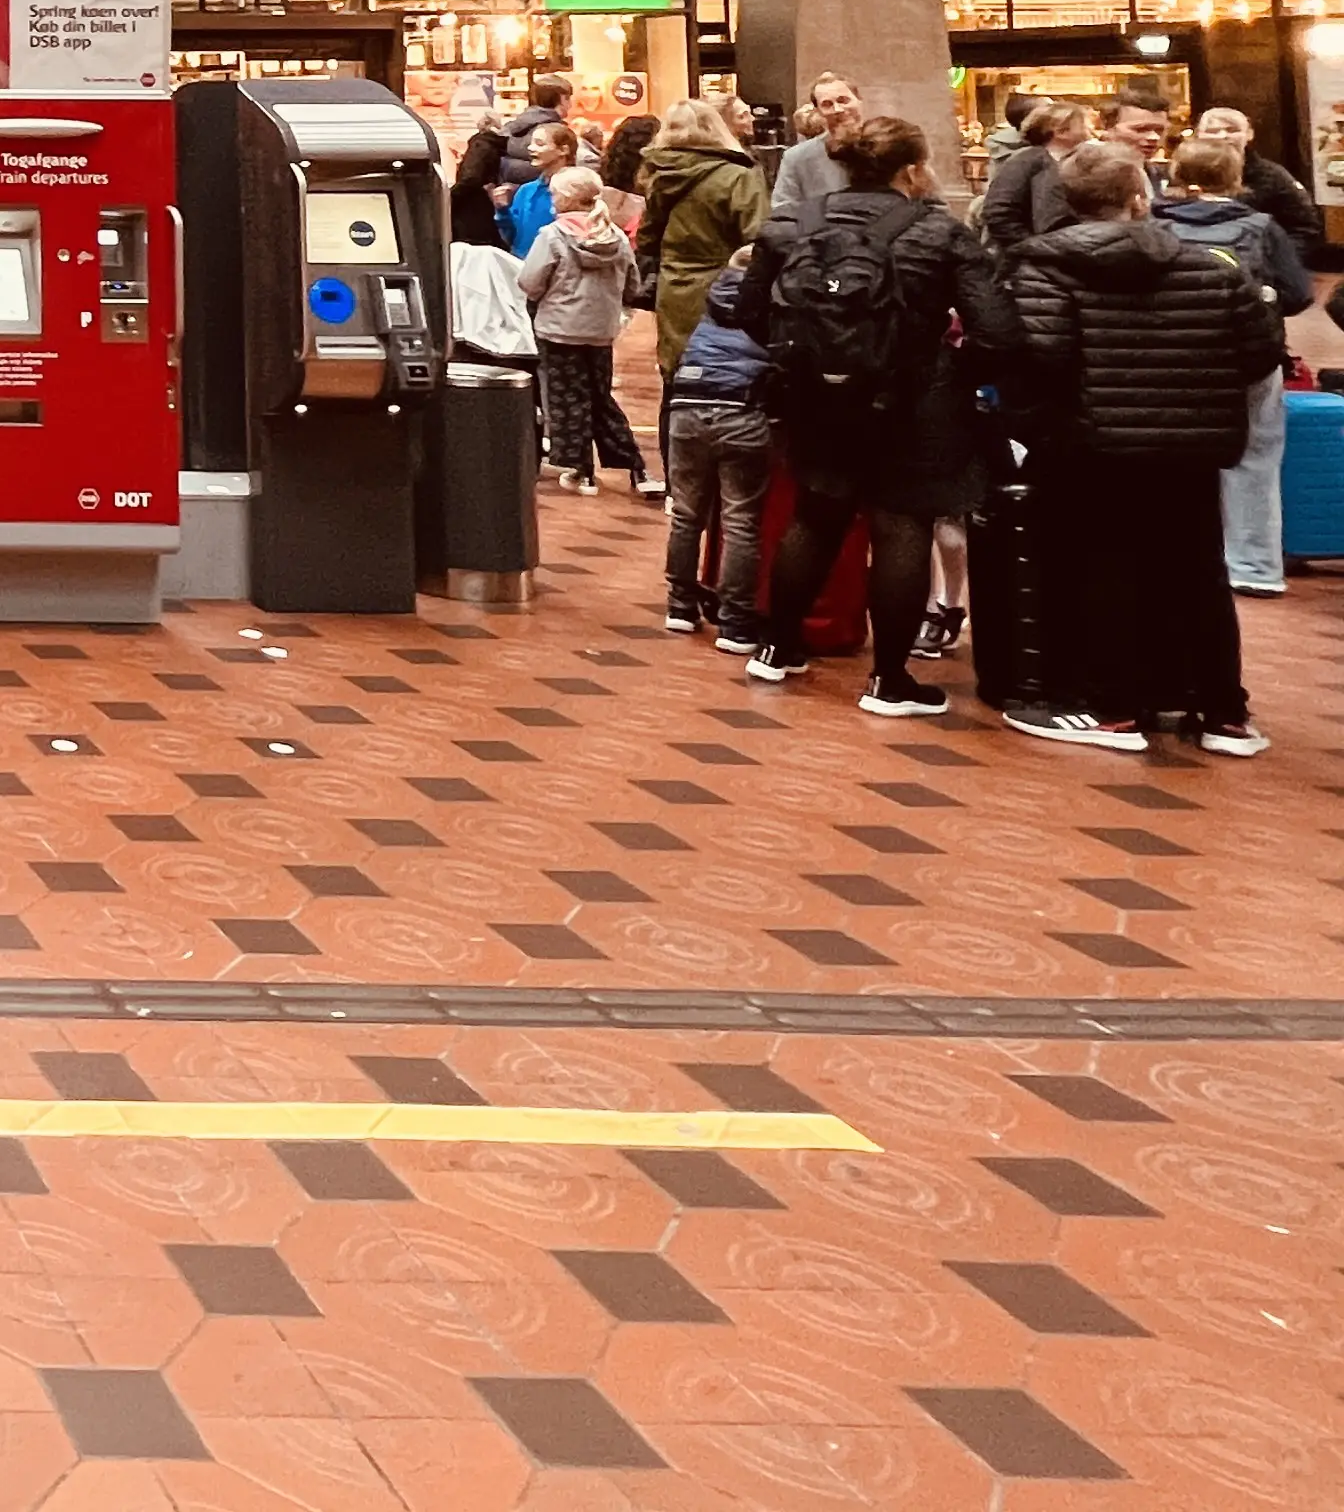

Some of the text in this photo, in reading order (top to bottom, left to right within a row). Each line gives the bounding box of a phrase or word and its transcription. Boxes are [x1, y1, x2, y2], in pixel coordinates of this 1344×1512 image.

[30, 5, 76, 20] Spring
[30, 20, 59, 32] Køb
[63, 20, 85, 32] din
[90, 20, 127, 32] billet
[30, 36, 91, 50] DSB app
[31, 171, 108, 186] departures
[115, 492, 152, 507] DOT
